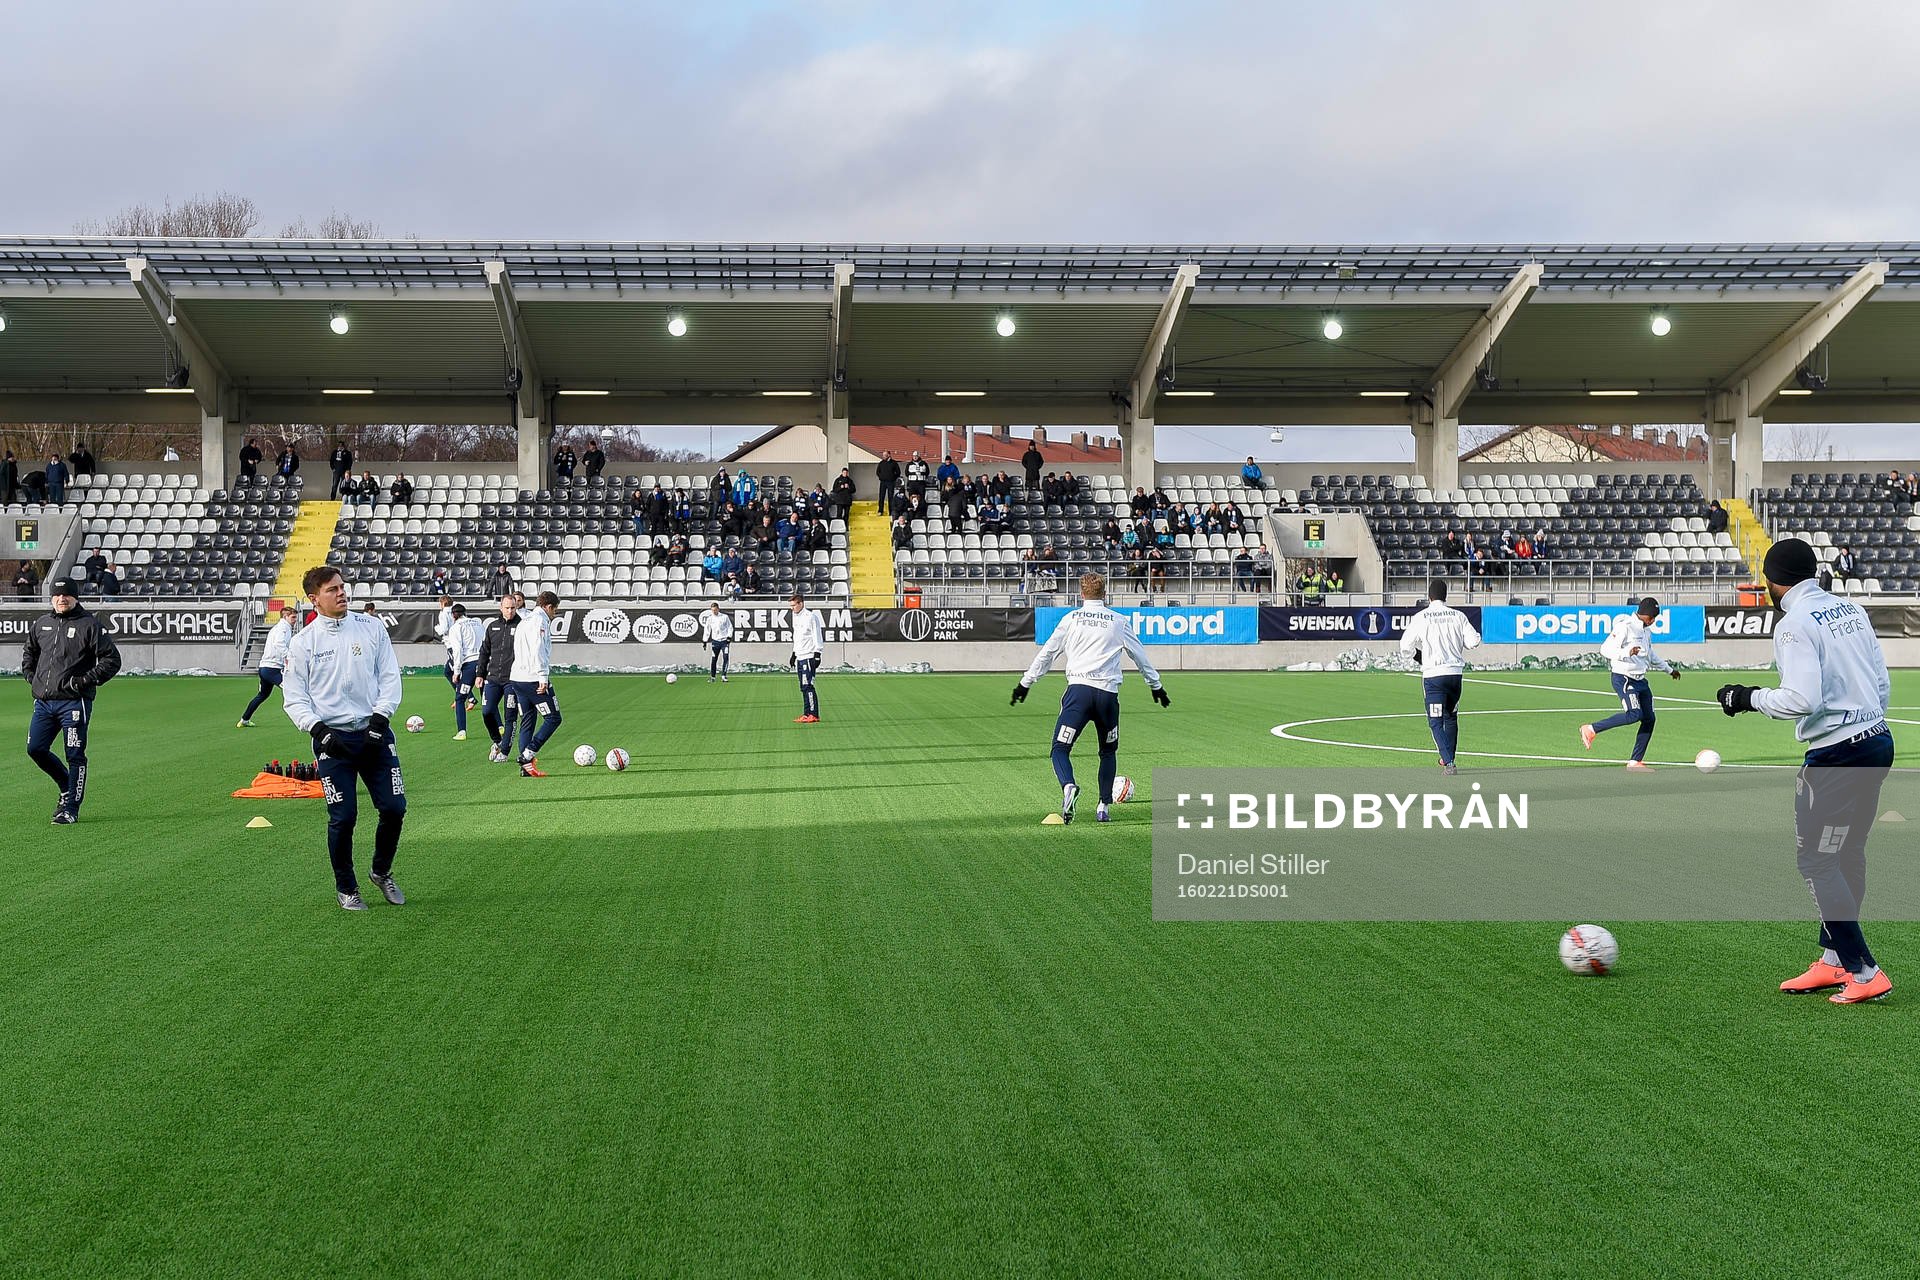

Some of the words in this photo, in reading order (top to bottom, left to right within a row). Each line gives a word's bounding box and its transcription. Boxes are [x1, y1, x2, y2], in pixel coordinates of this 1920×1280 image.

[21, 526, 33, 541] F
[1309, 525, 1320, 540] E
[734, 609, 853, 628] REKAM
[934, 610, 965, 619] SANKT
[108, 613, 163, 634] STIGS
[589, 616, 620, 632] mix
[638, 620, 661, 635] mix
[674, 618, 694, 630] mix
[934, 619, 974, 630] JÖRGEN
[1128, 610, 1224, 636] tnord
[1289, 615, 1355, 631] SVENSKA
[1391, 615, 1413, 631] CU
[1516, 609, 1670, 639] postnd
[588, 631, 619, 639] MEGAPOL
[734, 630, 853, 642] FABREN
[934, 631, 958, 640] PARK
